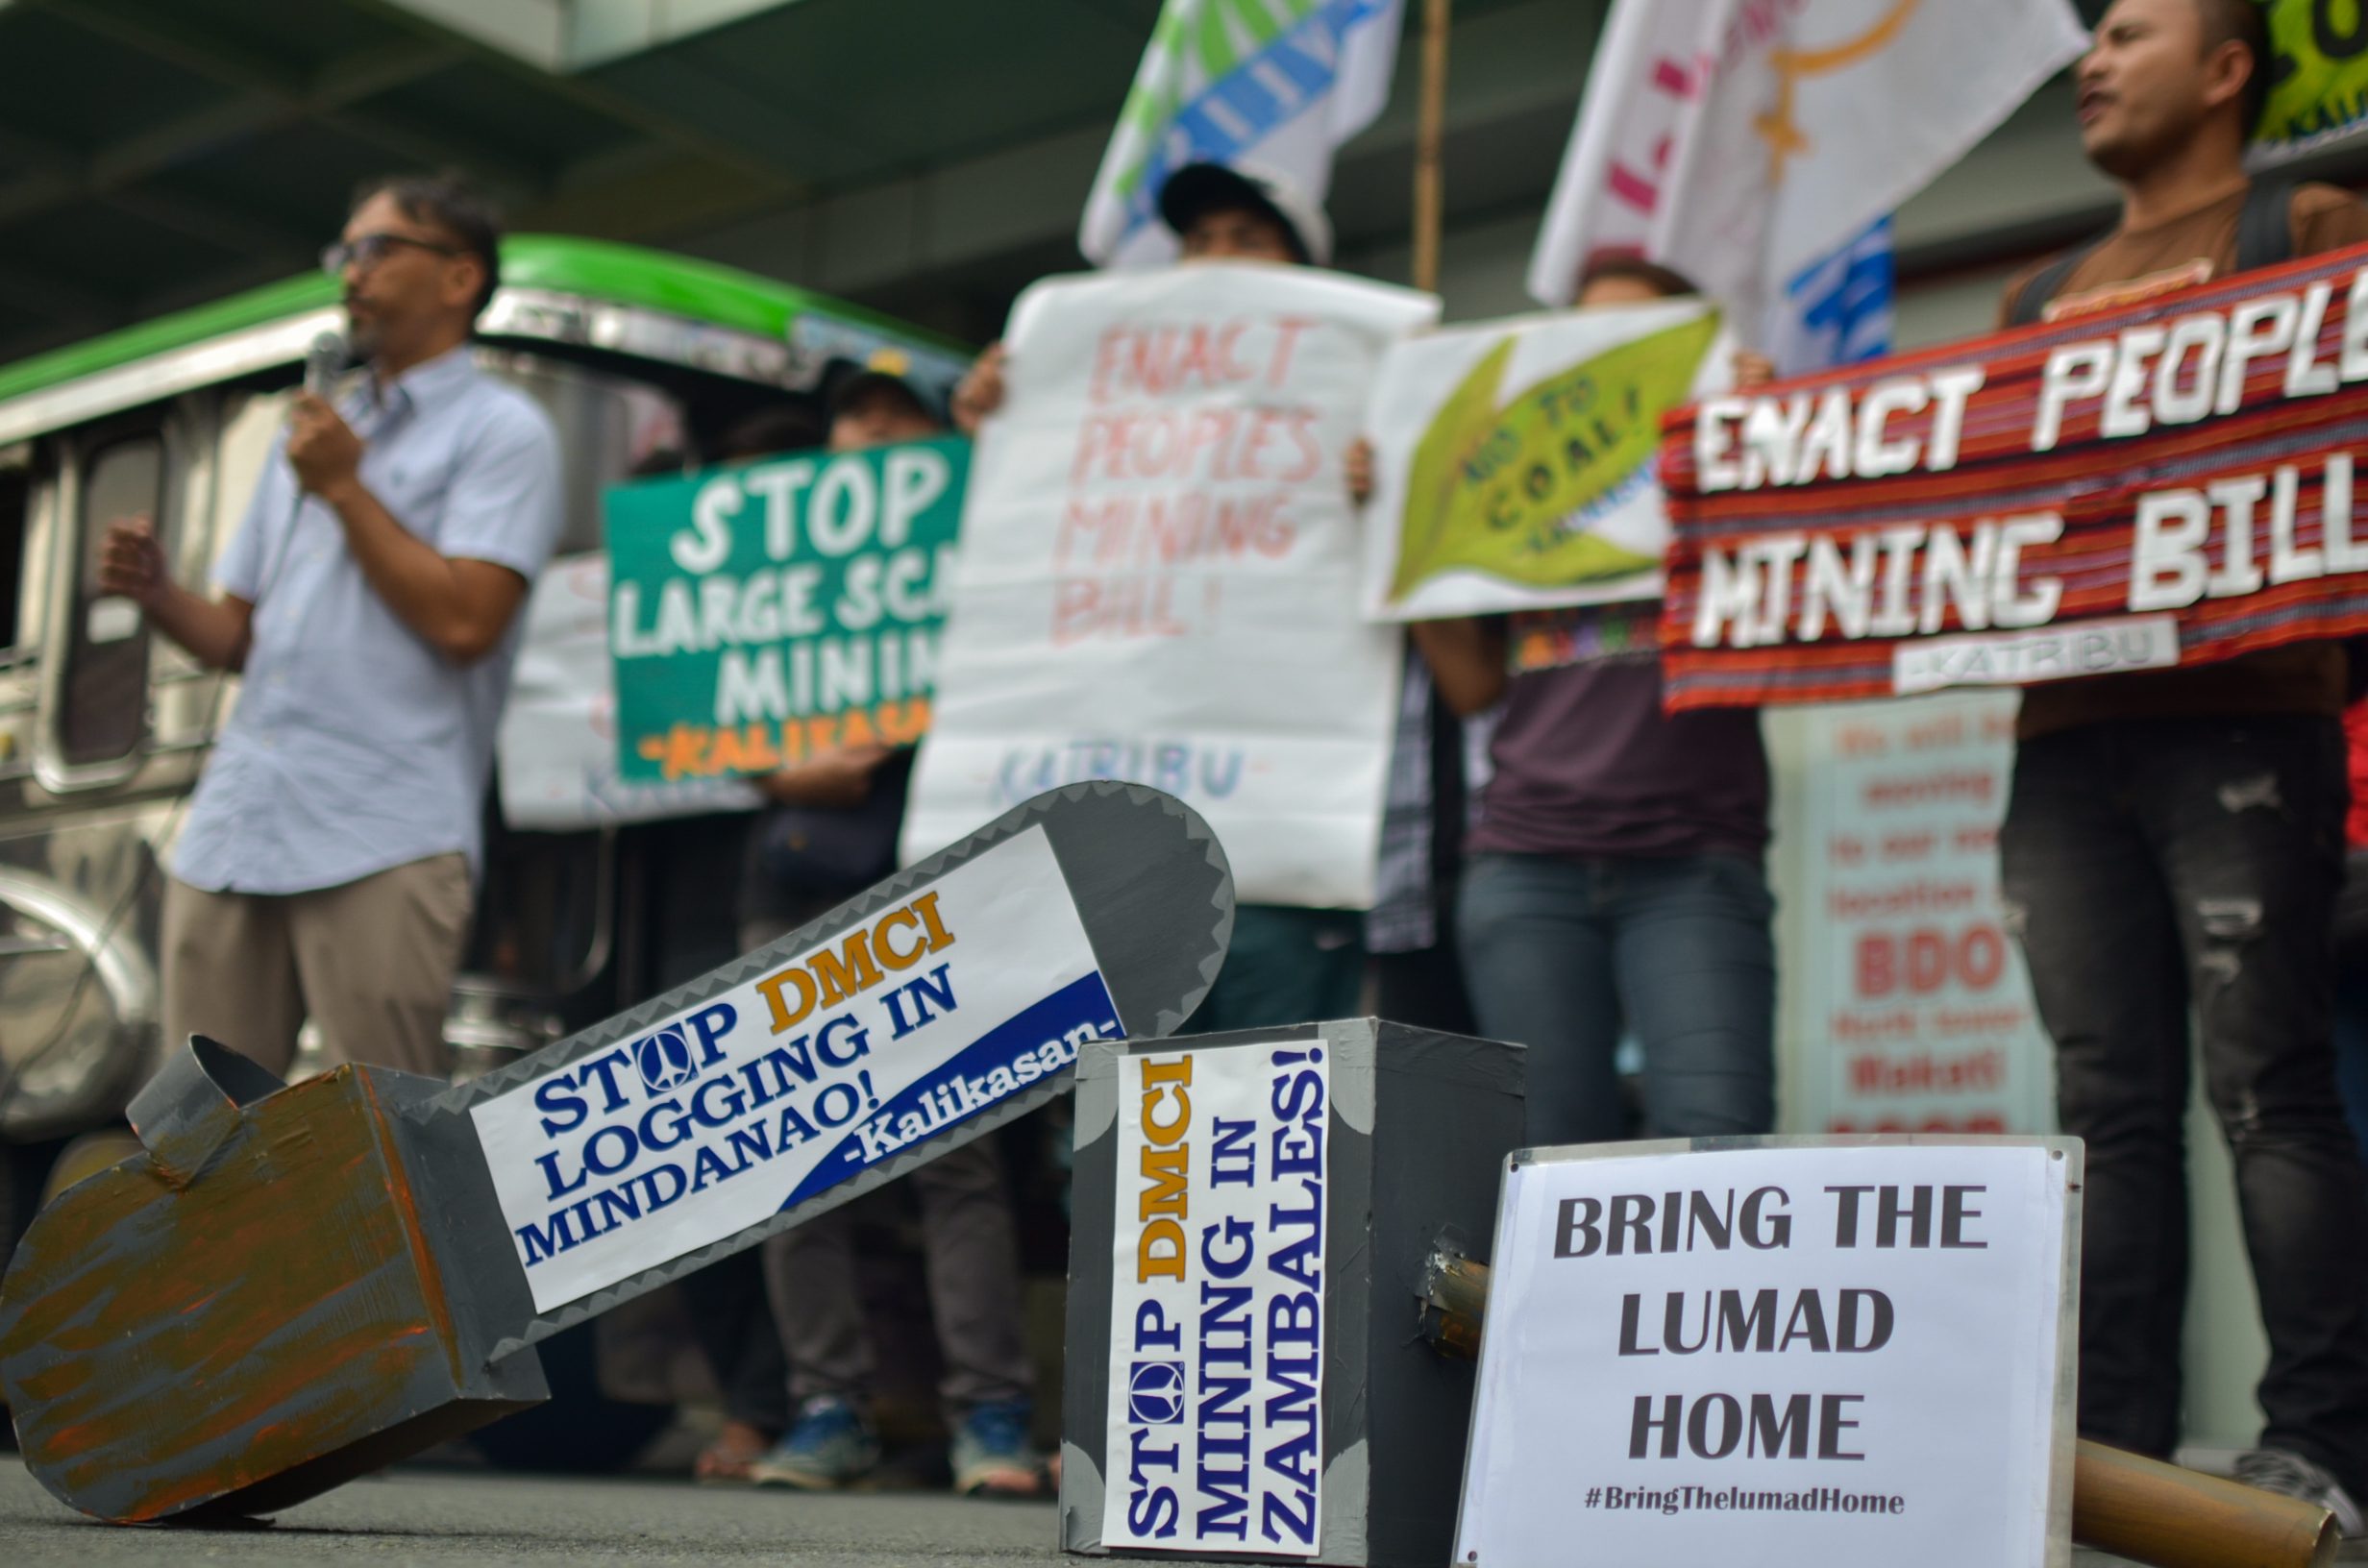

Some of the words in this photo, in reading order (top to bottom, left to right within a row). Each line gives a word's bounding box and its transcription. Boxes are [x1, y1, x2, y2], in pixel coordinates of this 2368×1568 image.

[1088, 312, 1324, 404] ENACT
[1695, 365, 1986, 494] ENACT
[671, 447, 950, 574] STOP
[1053, 490, 1299, 572] MINING
[1692, 510, 2064, 649] MINING
[2128, 452, 2368, 612] BILL
[612, 562, 825, 658] LARGE
[534, 1002, 738, 1139] STOP
[755, 892, 954, 1034] DMCI
[1855, 923, 2006, 998] BDO
[535, 1013, 870, 1201] LOGGING
[879, 963, 959, 1040] IN
[515, 1069, 880, 1266] MINDANAO!
[1137, 1054, 1193, 1283] DMCI
[1210, 1116, 1257, 1189] IN
[1553, 1186, 1792, 1260] BRING
[1823, 1185, 1988, 1250] THE
[1261, 1047, 1324, 1545] ZAMBALES!
[1617, 1287, 1895, 1357] LUMAD
[1127, 1299, 1185, 1540] STOP
[1196, 1215, 1255, 1542] MINING
[1628, 1392, 1866, 1461] HOME
[1585, 1485, 1905, 1516] #BringThelumadHome
